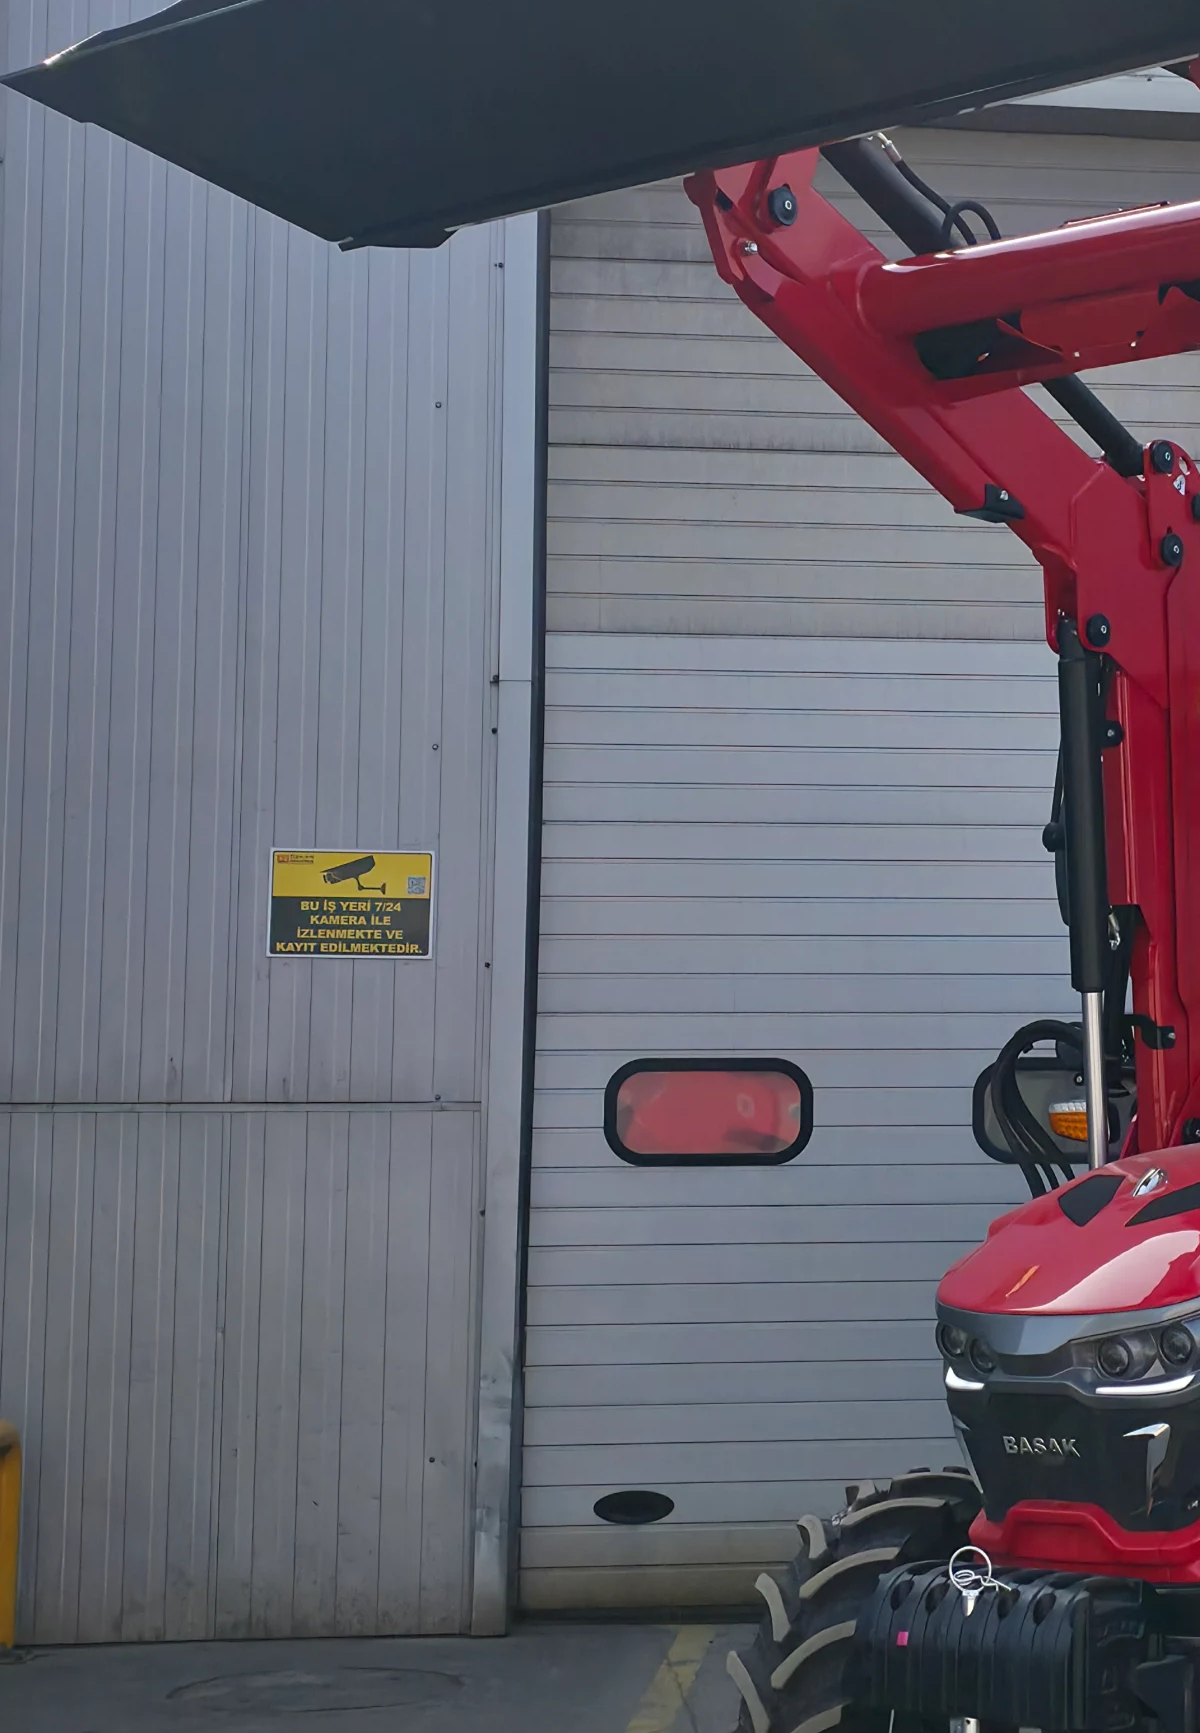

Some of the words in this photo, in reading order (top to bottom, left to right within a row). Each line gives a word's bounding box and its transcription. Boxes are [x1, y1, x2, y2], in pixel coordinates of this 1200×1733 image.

[300, 901, 319, 911] BU
[323, 899, 336, 914] İŞ
[340, 899, 371, 912] YERİ
[375, 902, 401, 912] 7/24
[310, 915, 367, 925] KAMERA
[371, 913, 391, 925] İLE
[297, 926, 382, 939] İZLENMEKTE
[386, 930, 403, 940] VE
[276, 942, 316, 952] KAYIT
[320, 941, 423, 954] EDİLMEKTEDİR.
[1002, 1435, 1081, 1457] BASAK
